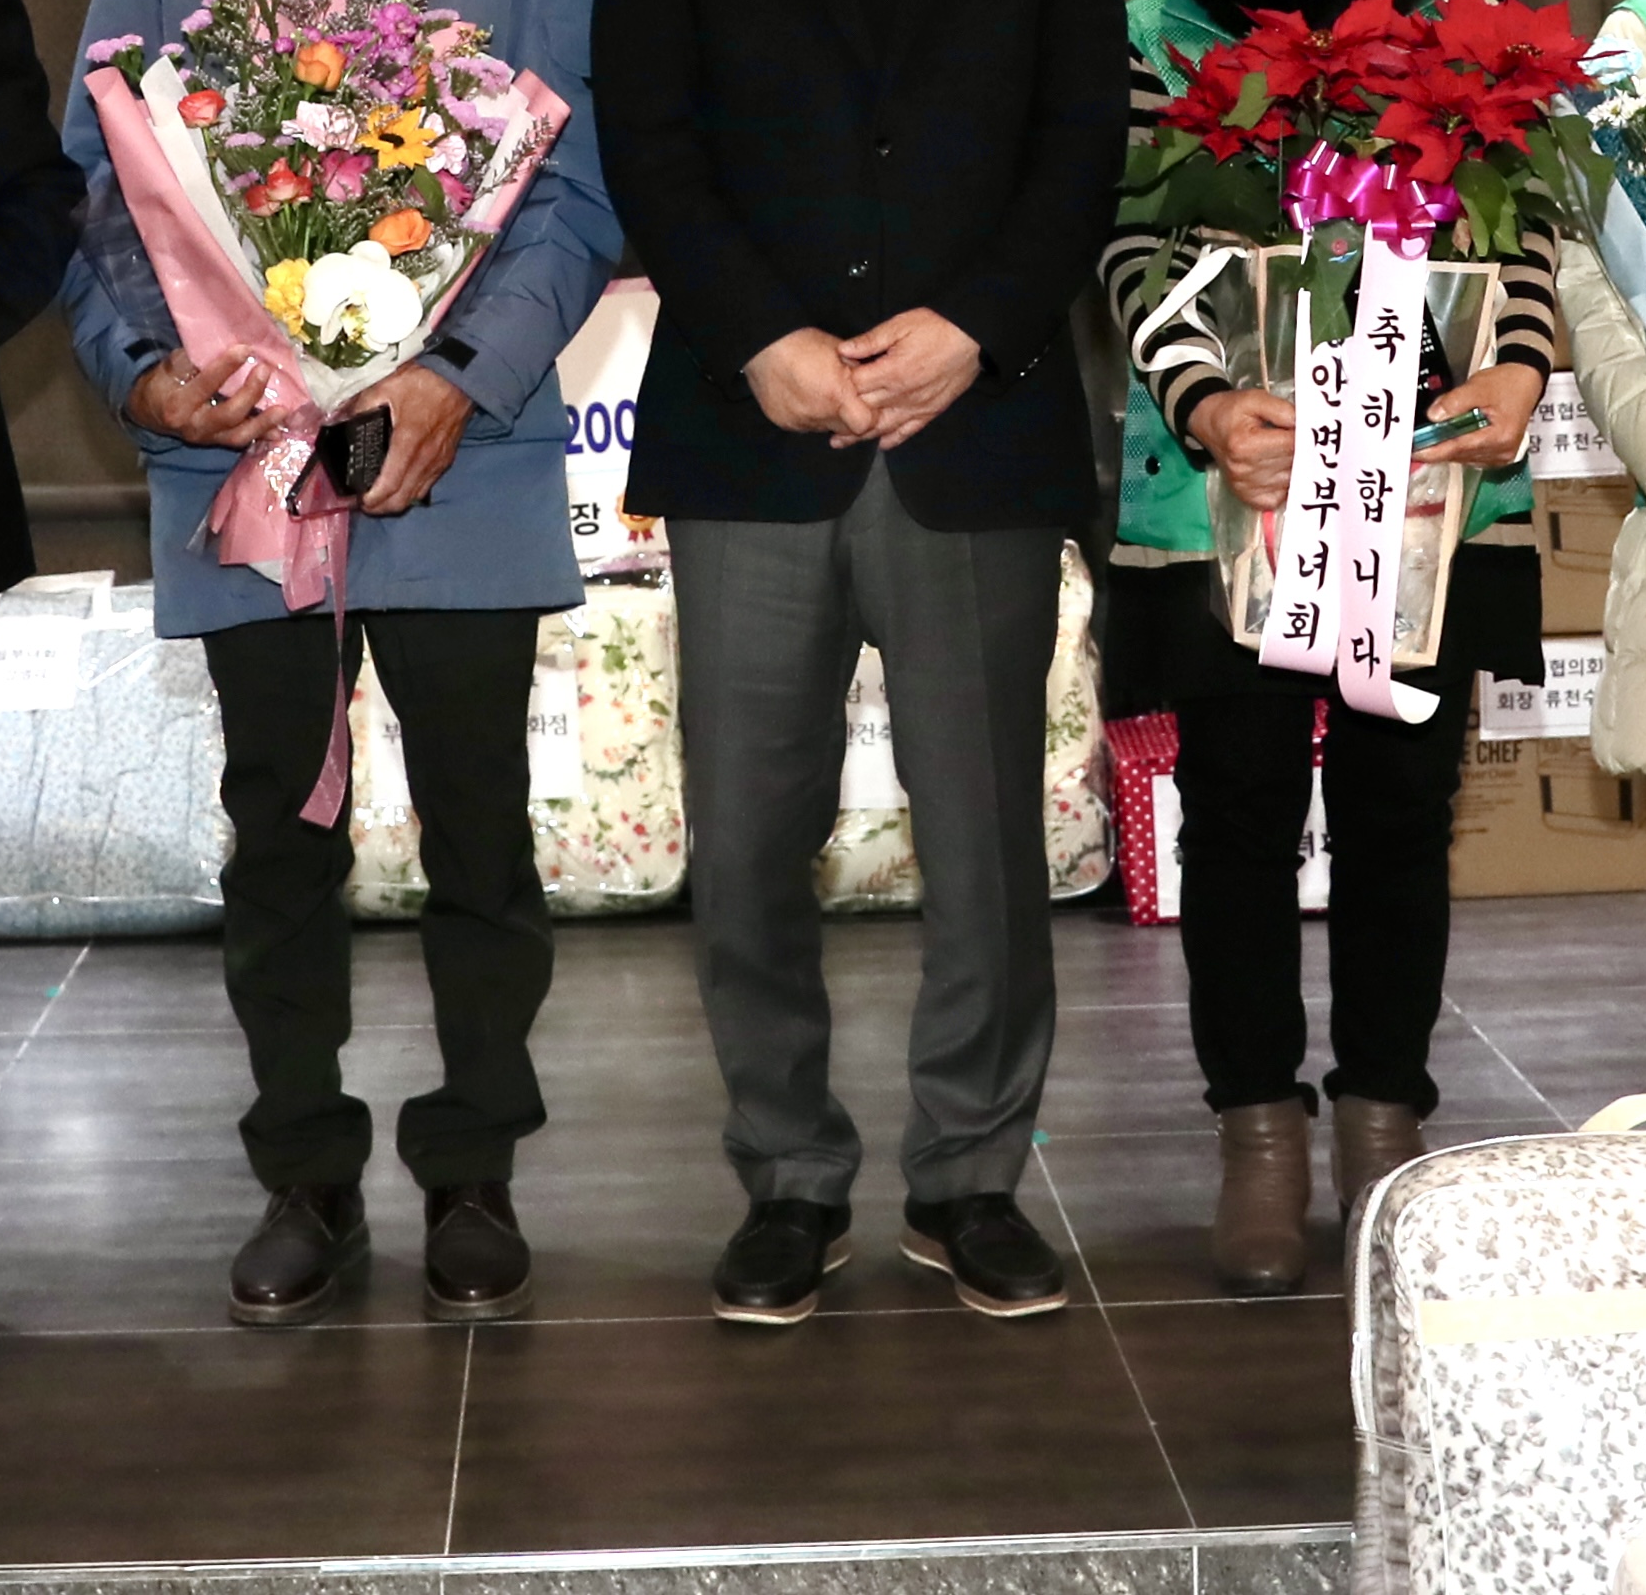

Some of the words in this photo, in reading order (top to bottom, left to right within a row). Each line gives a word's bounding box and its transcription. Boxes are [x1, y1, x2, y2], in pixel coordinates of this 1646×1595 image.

[1282, 338, 1349, 651] 안면부녀회
[1351, 307, 1406, 679] 축하합니다
[1476, 739, 1523, 765] CHEF
[1497, 691, 1534, 711] 회장
